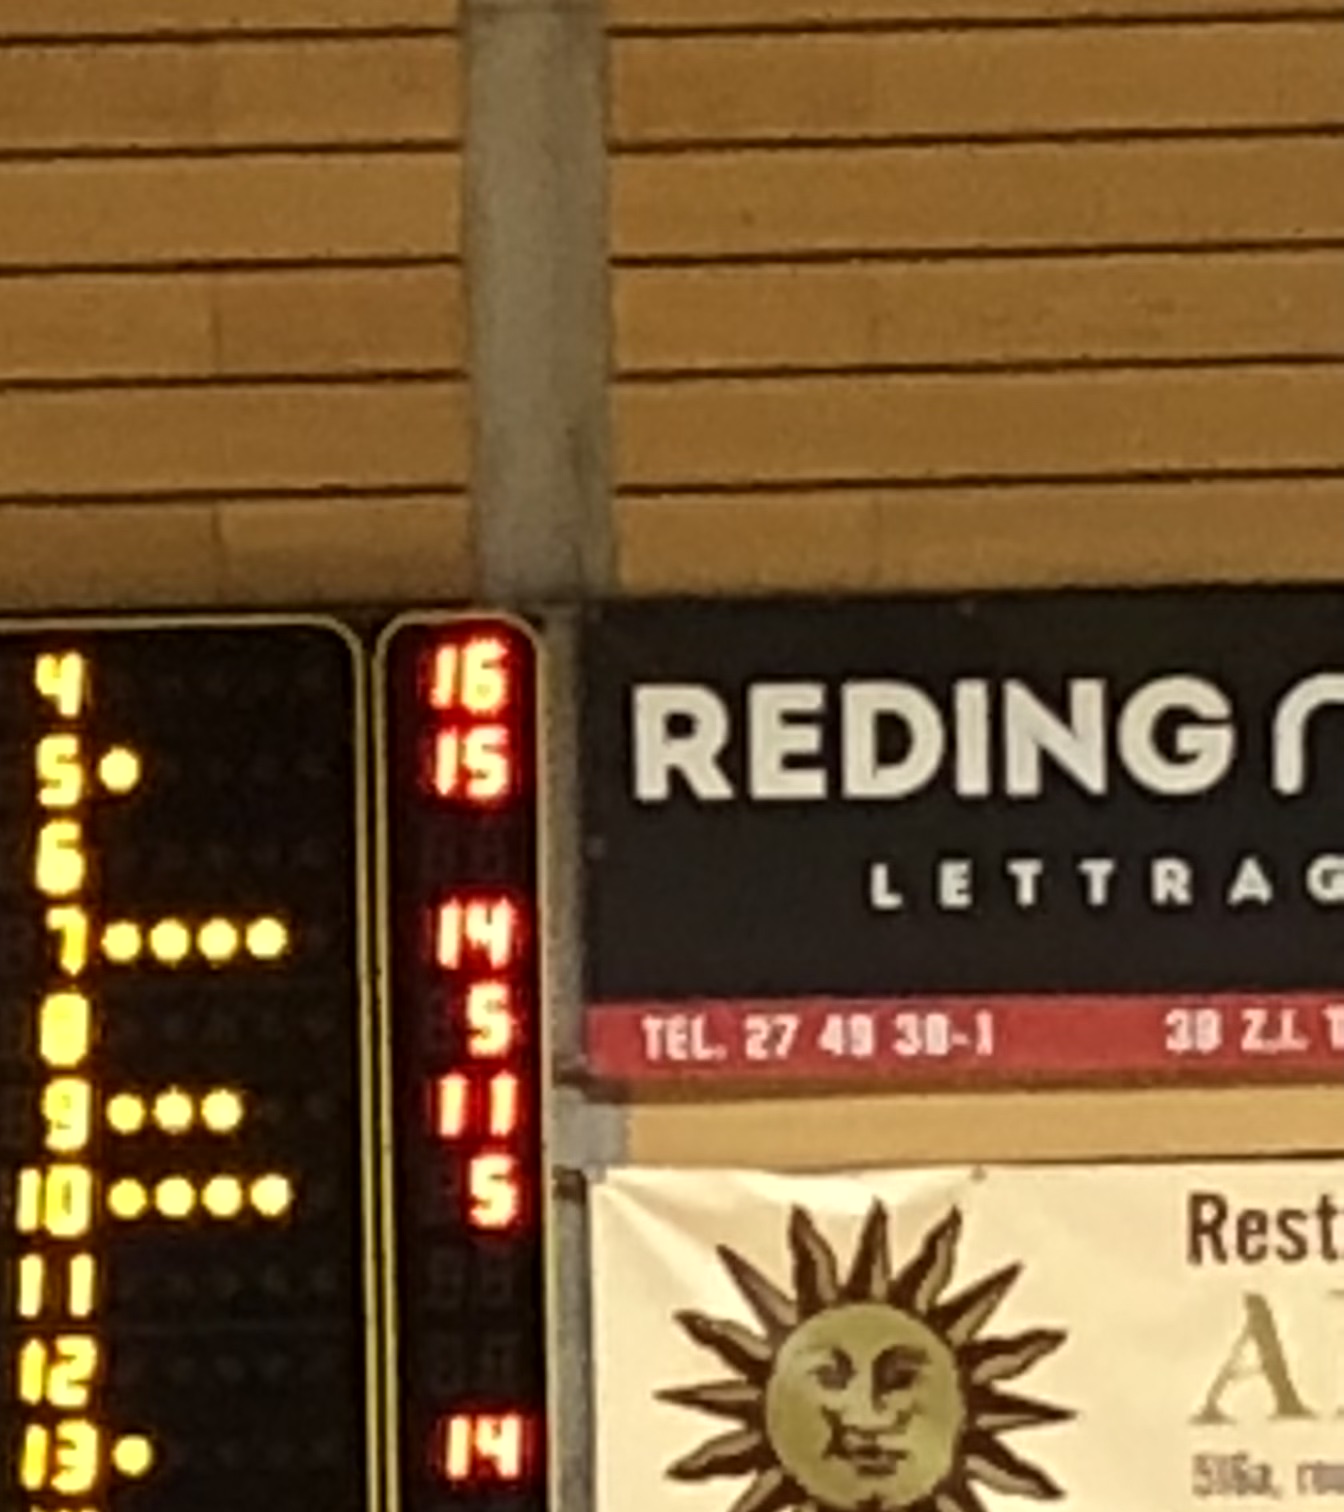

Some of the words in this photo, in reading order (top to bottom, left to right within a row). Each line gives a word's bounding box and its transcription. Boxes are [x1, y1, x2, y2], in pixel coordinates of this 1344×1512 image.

[35, 652, 83, 716] 4
[430, 639, 506, 713] 16
[36, 733, 82, 807] 5
[435, 726, 508, 798] 15
[631, 675, 1235, 801] REDING
[35, 818, 84, 895] 6
[870, 855, 1344, 910] LETTRAG
[46, 905, 87, 975] 7
[437, 898, 512, 970] 14
[466, 980, 510, 1056] 5
[641, 1013, 727, 1060] TEL.
[743, 1014, 800, 1060] 27
[42, 1077, 91, 1150] 9
[438, 1072, 517, 1137] 11
[16, 1163, 92, 1238] 10
[469, 1152, 517, 1228] 5
[1186, 1190, 1344, 1266] Rest
[18, 1253, 94, 1318] 11
[19, 1335, 97, 1408] 12
[1189, 1290, 1344, 1425] A
[20, 1420, 98, 1494] 13
[445, 1414, 520, 1480] 14
